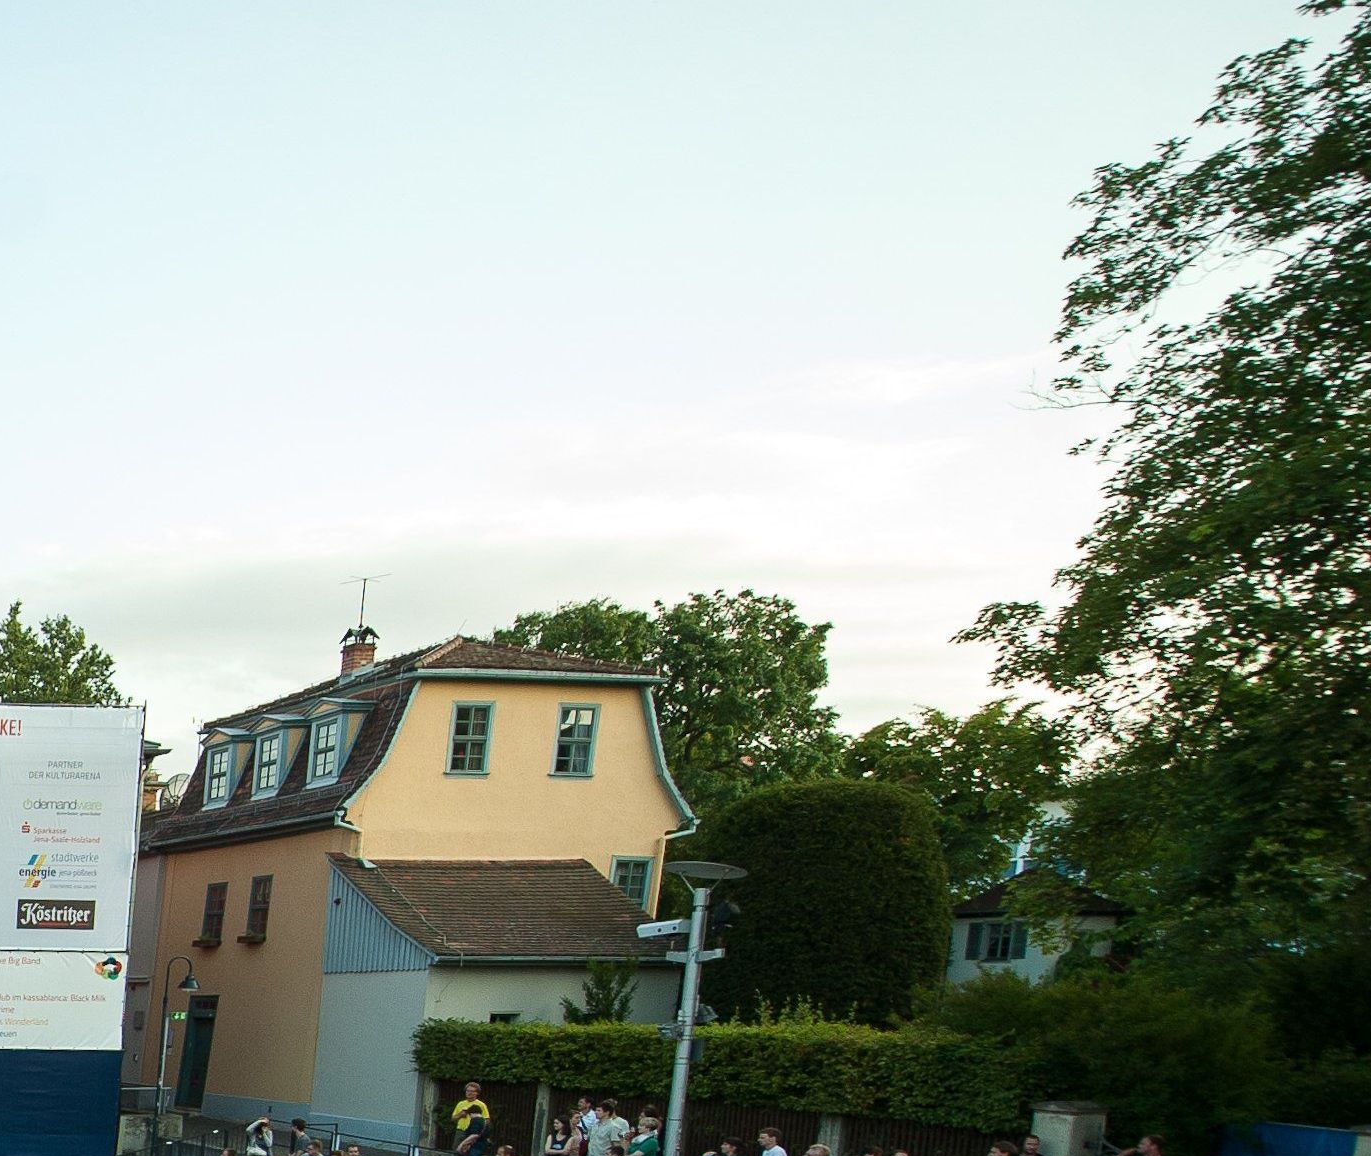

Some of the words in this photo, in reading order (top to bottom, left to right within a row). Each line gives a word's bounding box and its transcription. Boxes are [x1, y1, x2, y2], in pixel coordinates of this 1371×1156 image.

[47, 760, 84, 769] PARTNER
[28, 771, 44, 779] DER
[45, 771, 101, 780] KULTURARENA
[33, 827, 67, 835] Sparkasse
[50, 852, 100, 863] stadtwerke
[18, 866, 57, 880] energie
[20, 902, 91, 926] Köstritzer
